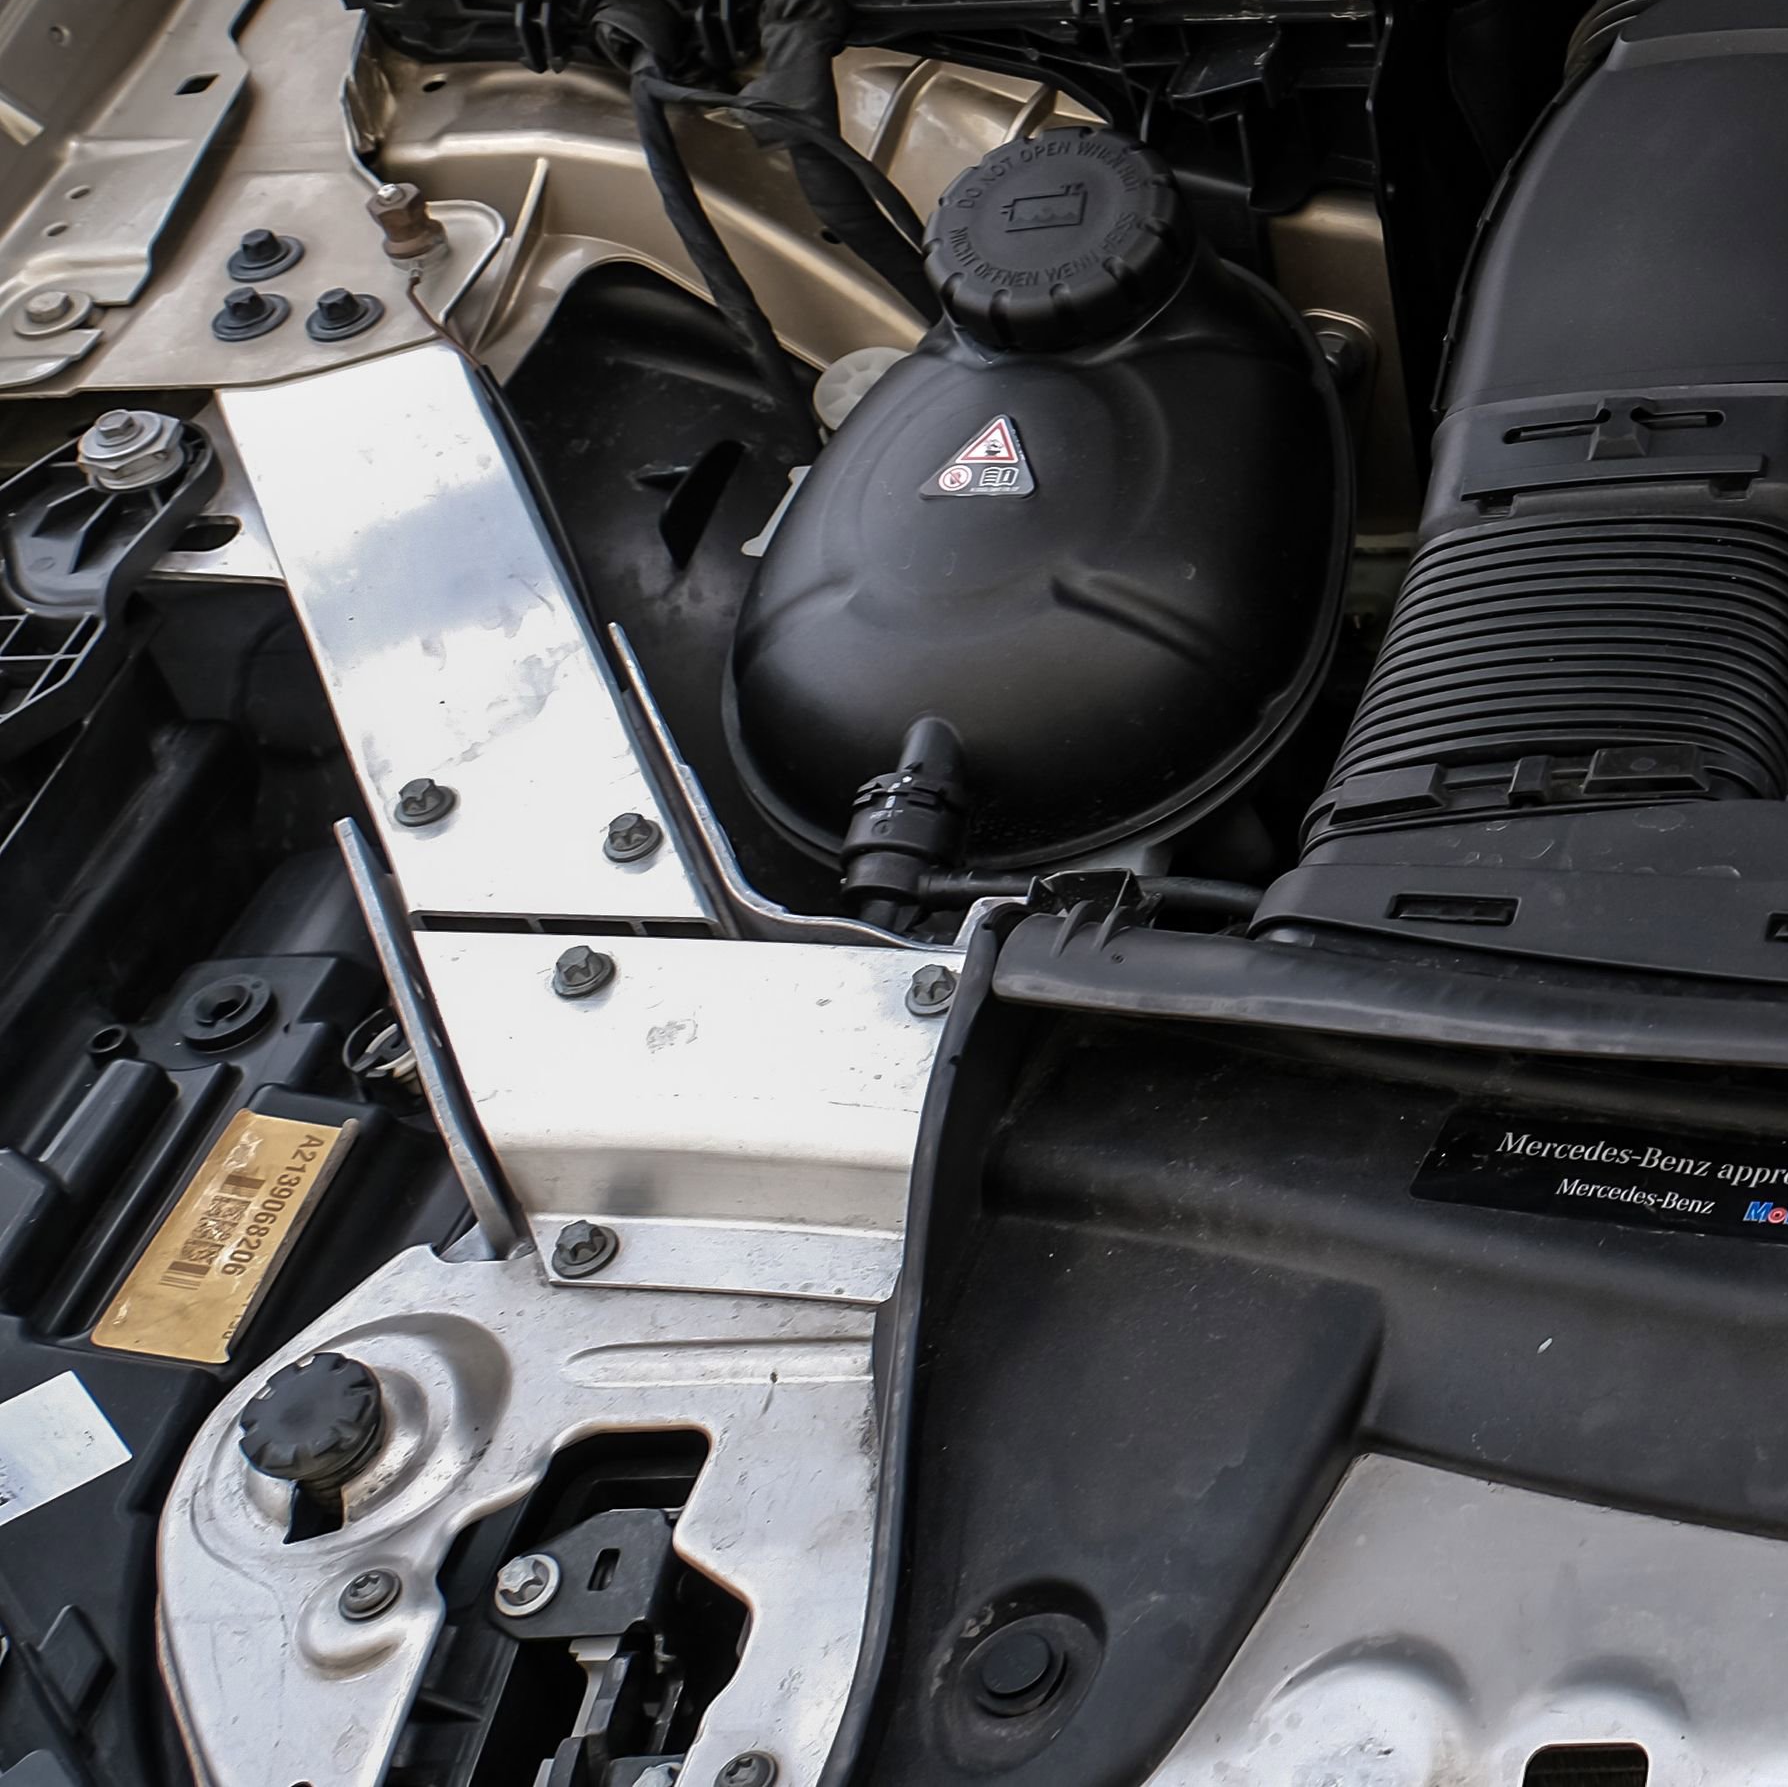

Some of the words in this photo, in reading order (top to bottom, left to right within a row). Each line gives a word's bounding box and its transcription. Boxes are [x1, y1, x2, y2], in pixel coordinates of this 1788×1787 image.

[957, 186, 983, 210] DO
[981, 155, 1016, 189] NOT
[1020, 140, 1072, 163] OPEN
[1045, 248, 1101, 283] WENN
[1495, 1131, 1713, 1178] Mercedes-Benz
[221, 1133, 326, 1277] A2139068206
[1554, 1177, 1716, 1215] Mercedes-Benz
